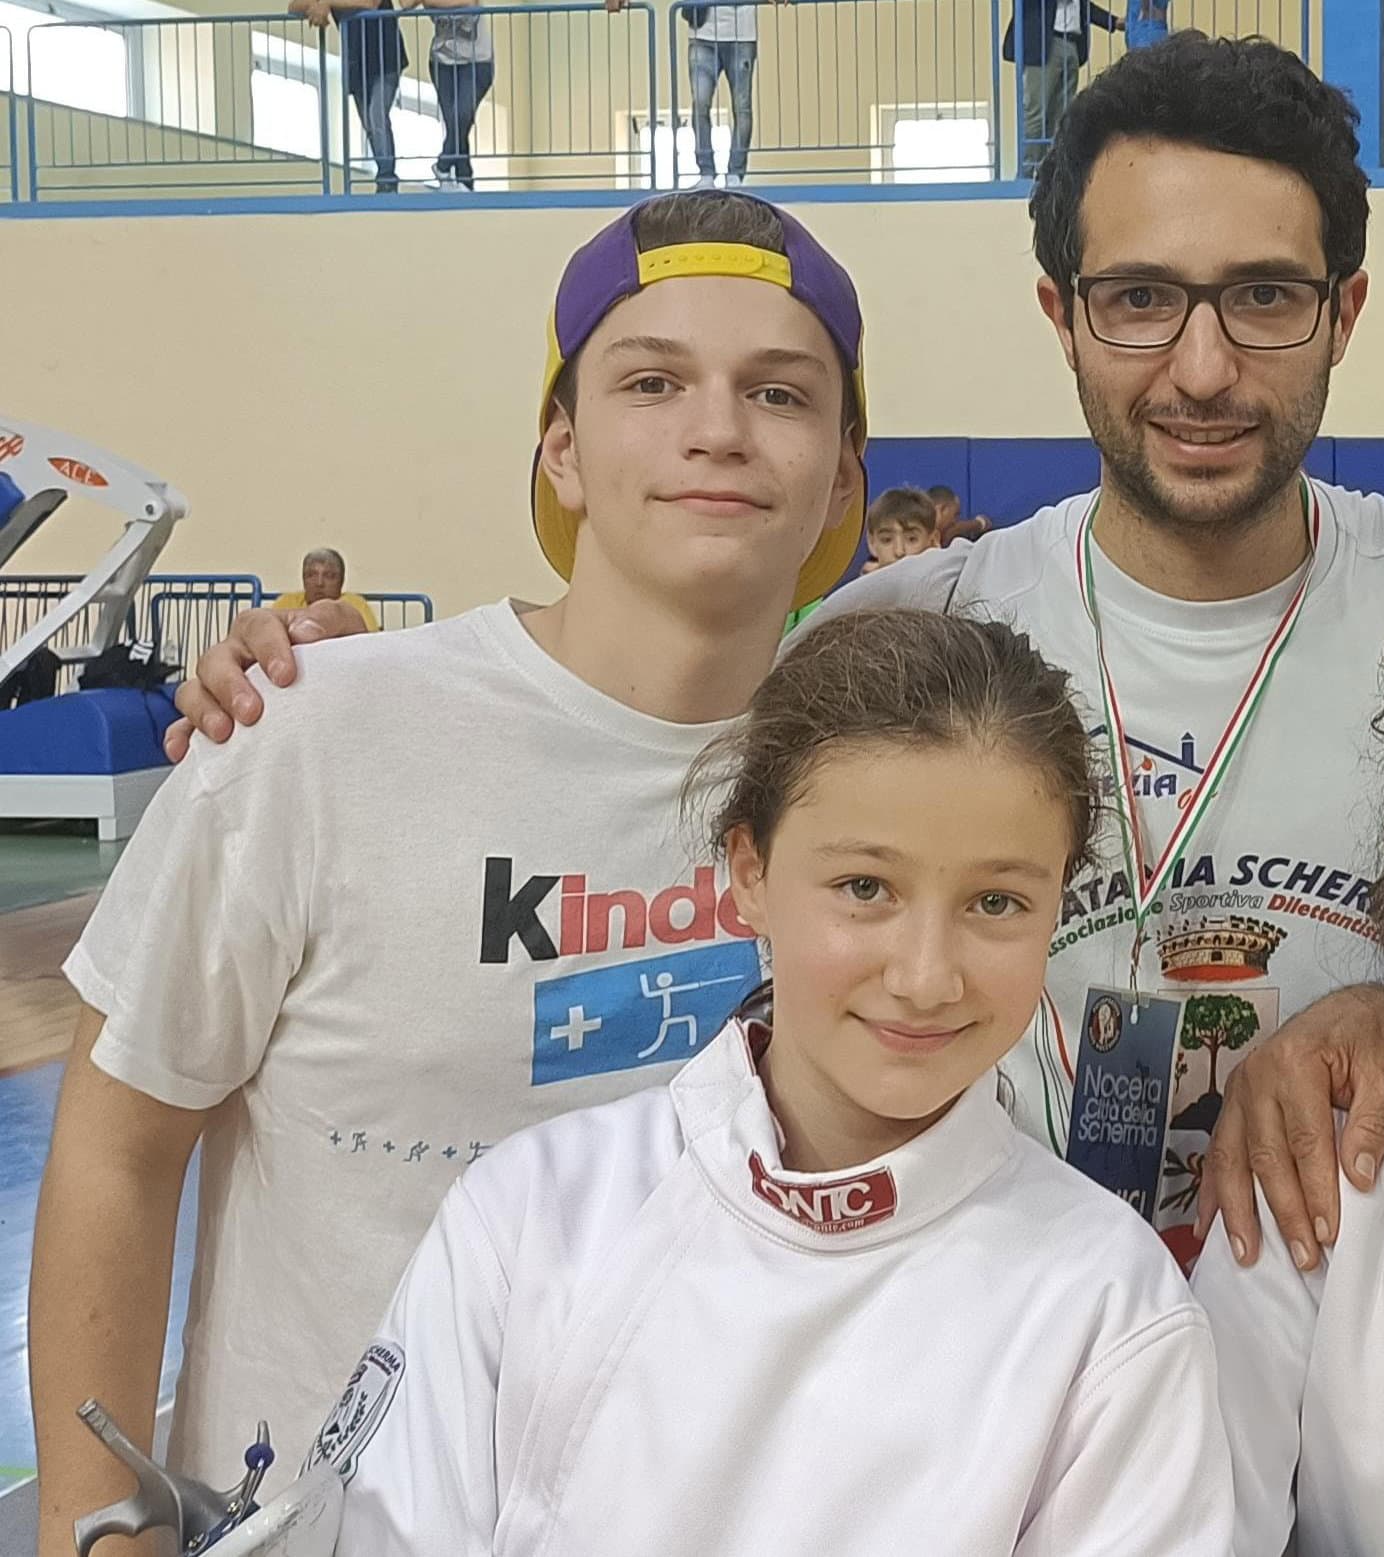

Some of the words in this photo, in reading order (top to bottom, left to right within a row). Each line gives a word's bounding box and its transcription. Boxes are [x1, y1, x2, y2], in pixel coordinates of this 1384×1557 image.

[1169, 889, 1264, 914] Sportiva
[1229, 854, 1376, 914] SCHER
[1083, 1063, 1162, 1104] Nocera
